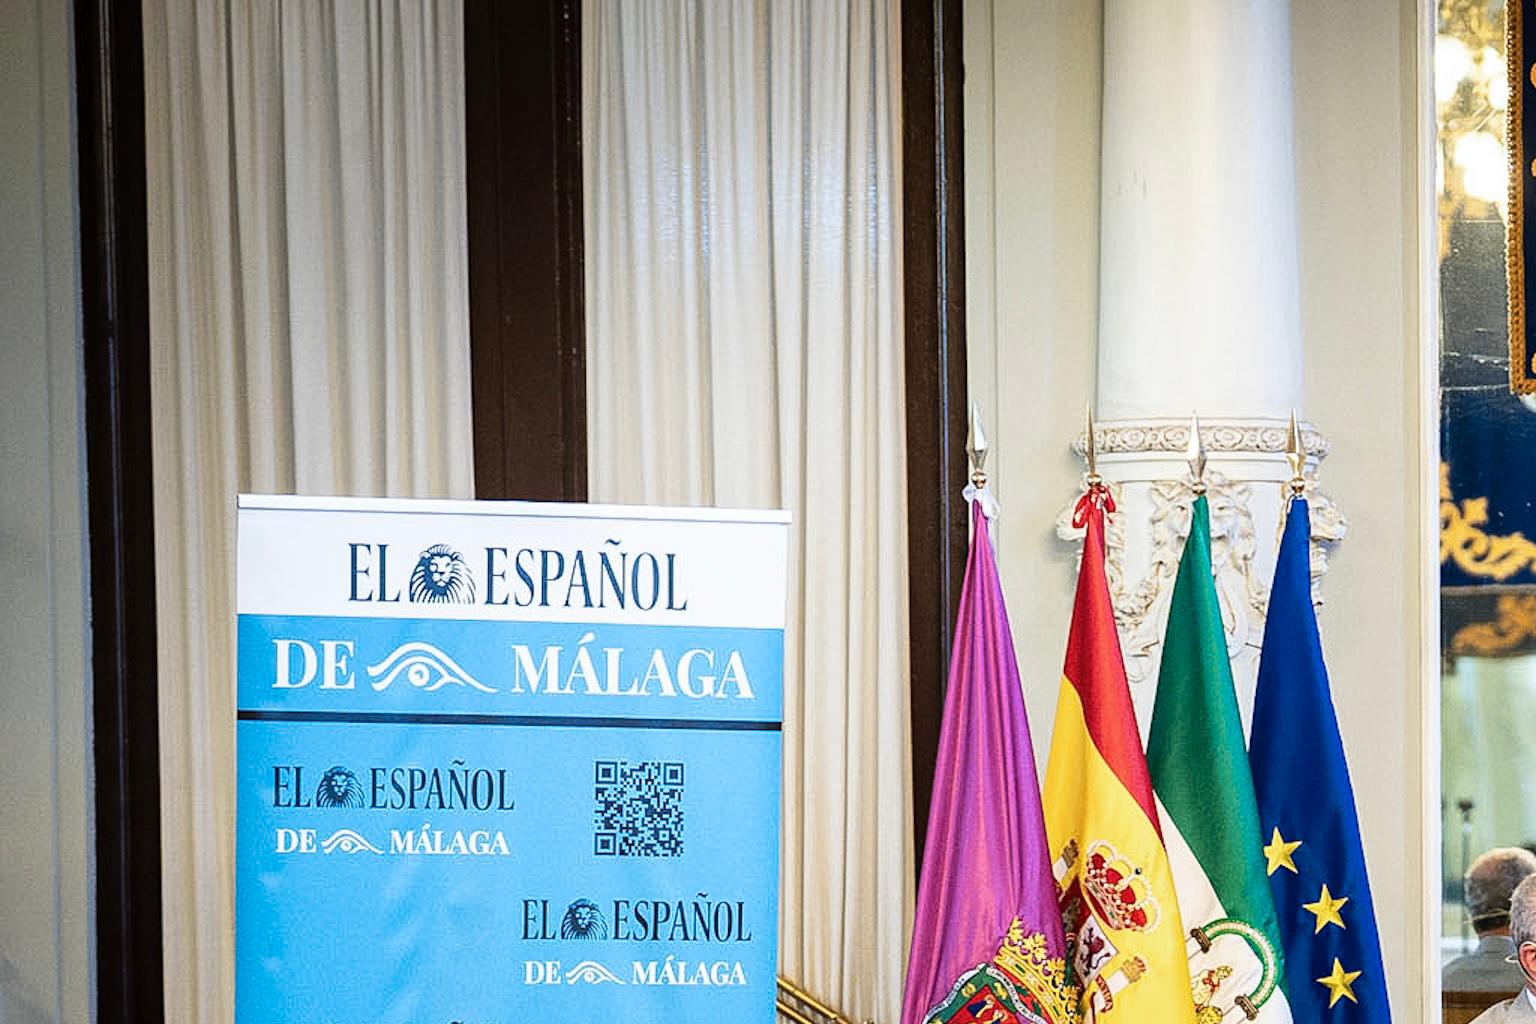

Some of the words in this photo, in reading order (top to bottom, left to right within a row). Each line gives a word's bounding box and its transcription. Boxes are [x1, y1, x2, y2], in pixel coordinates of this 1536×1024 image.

[347, 542, 401, 602] EL
[484, 538, 688, 611] ESPAÑOL
[271, 638, 356, 690] DE
[511, 632, 755, 699] MÁLAGA
[272, 766, 311, 808] EL
[369, 759, 515, 811] ESPAÑOL
[275, 829, 317, 854] DE
[389, 823, 511, 855] MÁLAGA
[521, 899, 556, 941] EL
[611, 892, 752, 942] ESPAÑOL
[524, 961, 561, 986] DE
[632, 954, 747, 986] MÁLAGA
